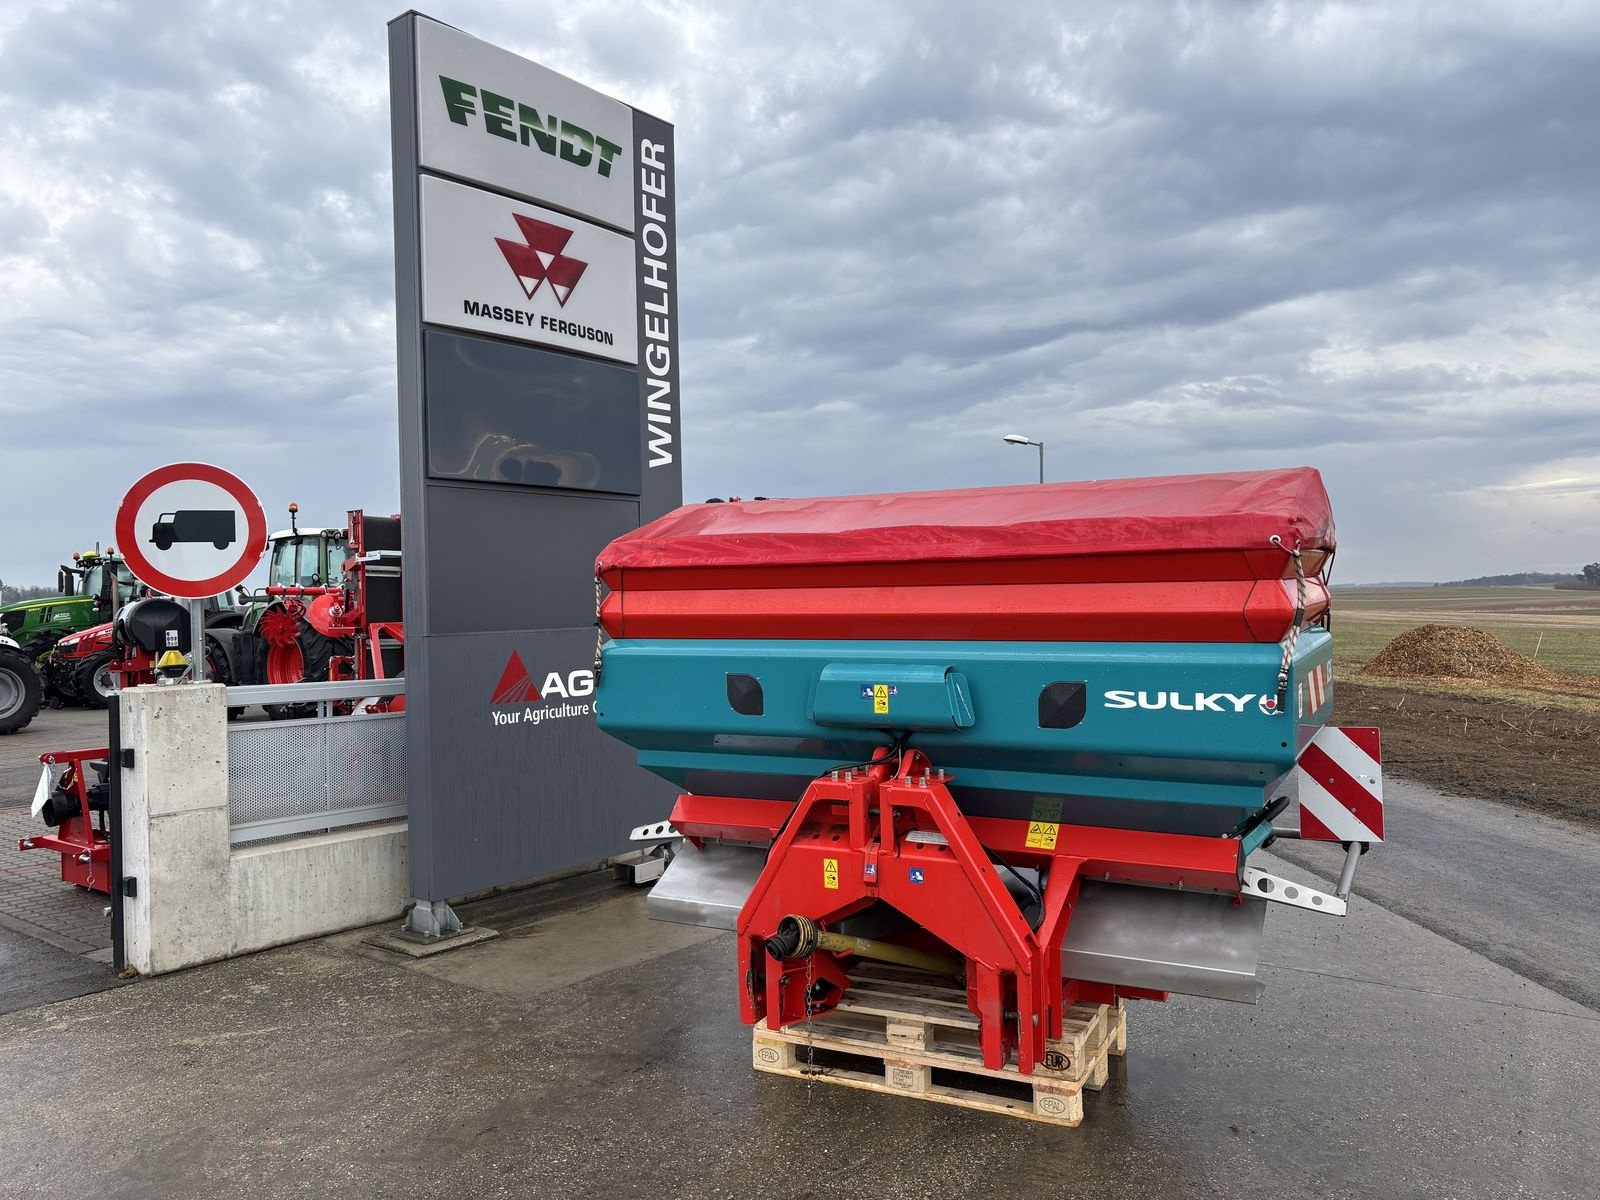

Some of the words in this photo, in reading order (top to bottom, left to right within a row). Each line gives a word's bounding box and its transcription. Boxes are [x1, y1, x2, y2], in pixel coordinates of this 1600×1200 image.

[439, 75, 623, 178] FENDT
[640, 137, 673, 468] WINGELHOFER
[463, 300, 535, 327] MASSEY
[540, 315, 614, 346] FERGUSON
[492, 711, 521, 726] Your
[523, 702, 589, 725] Agriculture
[1103, 690, 1257, 713] SULKY
[1045, 1053, 1064, 1070] EUR
